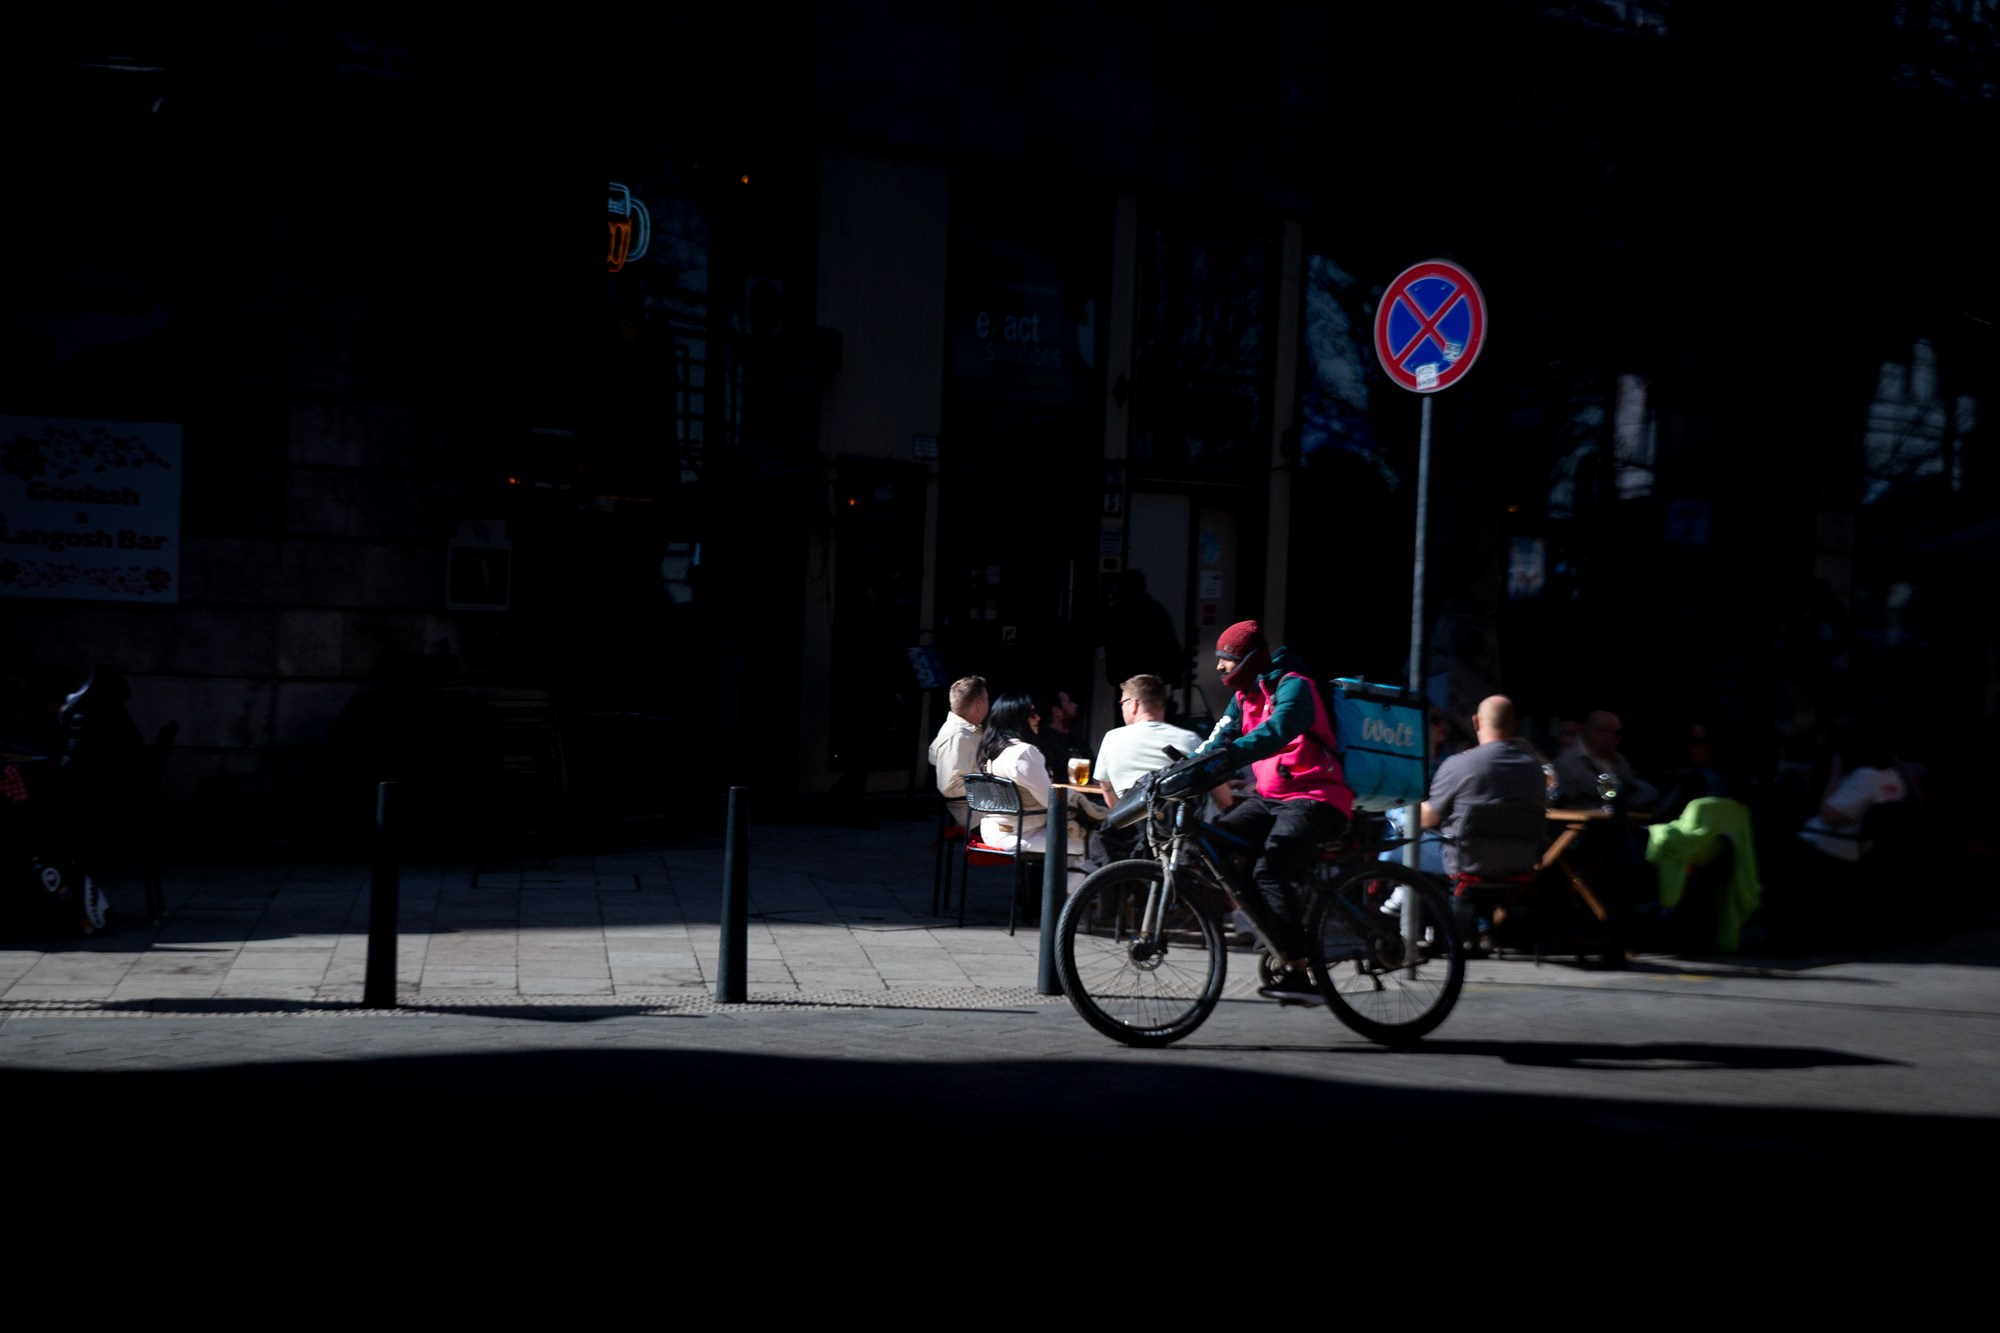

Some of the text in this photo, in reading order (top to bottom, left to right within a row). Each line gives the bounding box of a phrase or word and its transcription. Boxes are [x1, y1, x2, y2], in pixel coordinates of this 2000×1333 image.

[27, 481, 140, 506] Goulash
[75, 511, 90, 525] &
[0, 524, 168, 552] Langosh Bar
[1361, 717, 1415, 748] Wolt
